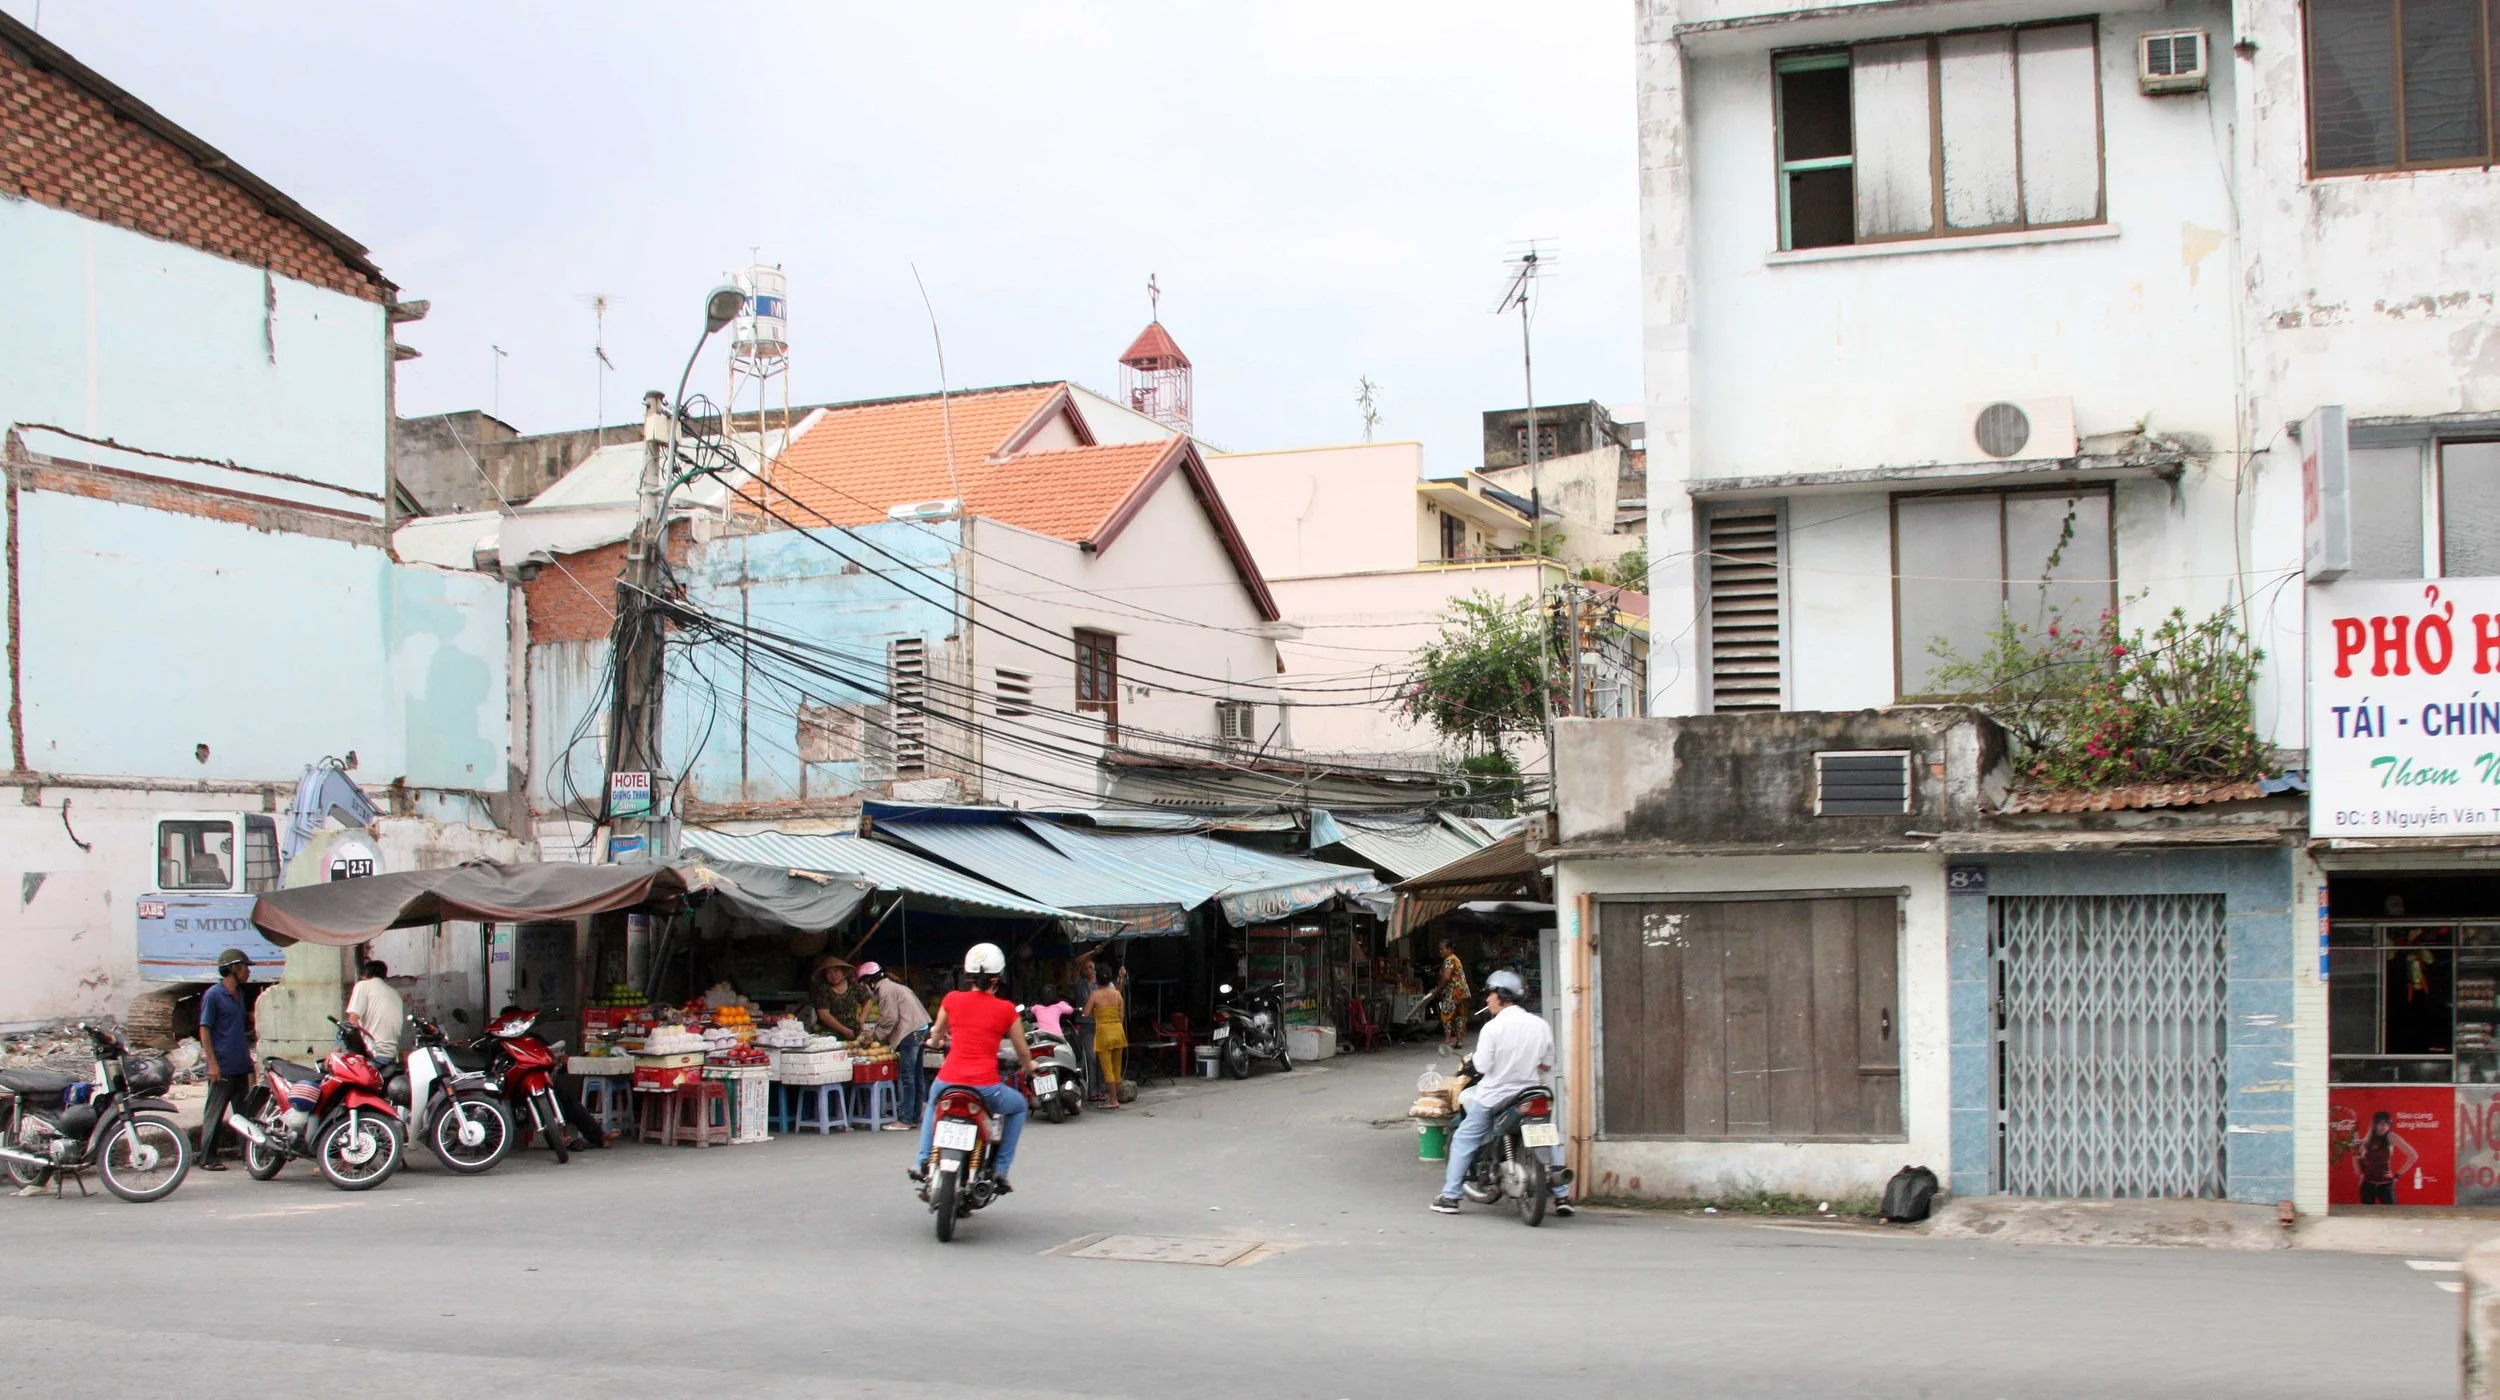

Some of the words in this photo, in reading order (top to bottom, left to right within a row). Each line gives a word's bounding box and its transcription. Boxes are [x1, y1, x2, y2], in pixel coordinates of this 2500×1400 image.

[2332, 584, 2454, 678] PHỞ
[2331, 696, 2385, 738] TÁI
[2422, 690, 2500, 736] CHÍN
[615, 774, 648, 787] HOTEL
[2371, 756, 2460, 788] Thơm
[2336, 811, 2365, 825] ĐC:
[2371, 811, 2380, 825] 8
[2386, 806, 2447, 828] Nguyễn
[2454, 808, 2485, 823] Văn
[1949, 871, 1984, 888] 8A
